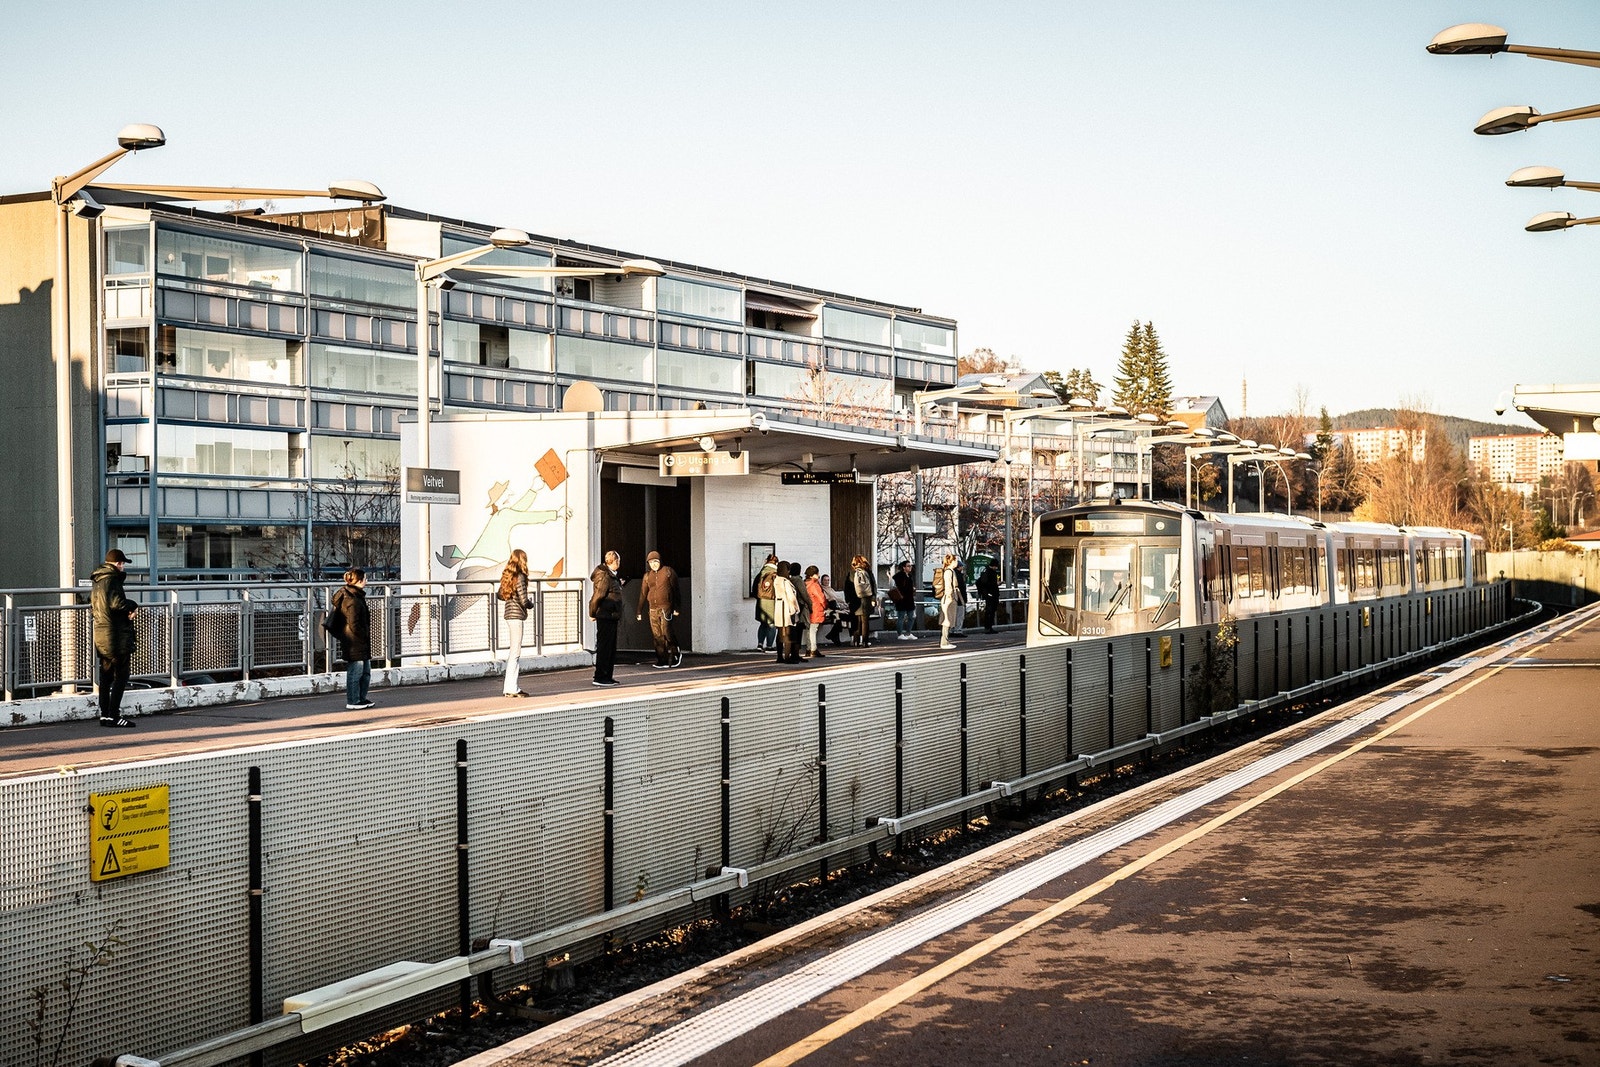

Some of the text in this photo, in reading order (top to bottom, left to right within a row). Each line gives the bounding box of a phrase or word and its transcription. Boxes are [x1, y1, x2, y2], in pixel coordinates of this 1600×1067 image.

[688, 456, 719, 466] Utgang
[423, 475, 444, 488] Veitvet
[1082, 627, 1105, 635] 33100
